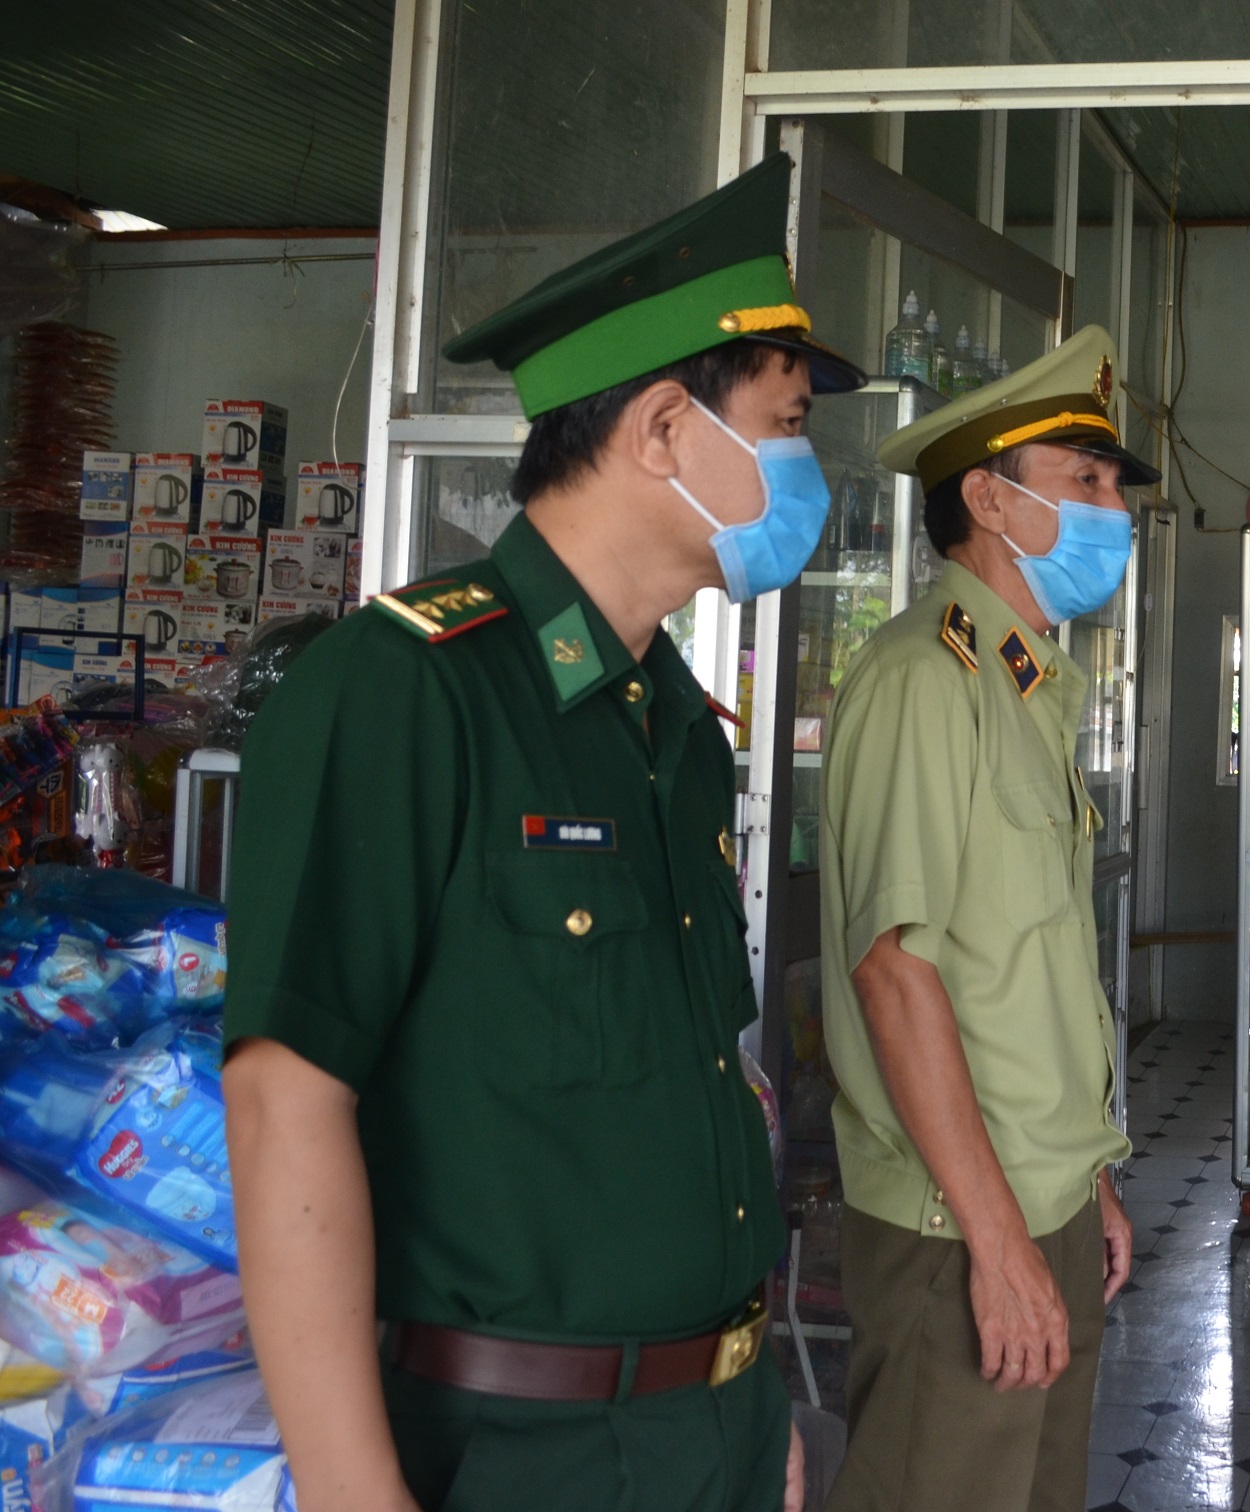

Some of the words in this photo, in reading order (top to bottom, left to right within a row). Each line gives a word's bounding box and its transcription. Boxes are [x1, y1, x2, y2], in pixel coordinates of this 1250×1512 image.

[270, 534, 282, 542] KIM
[216, 541, 231, 549] KIM
[262, 600, 274, 608] KIM
